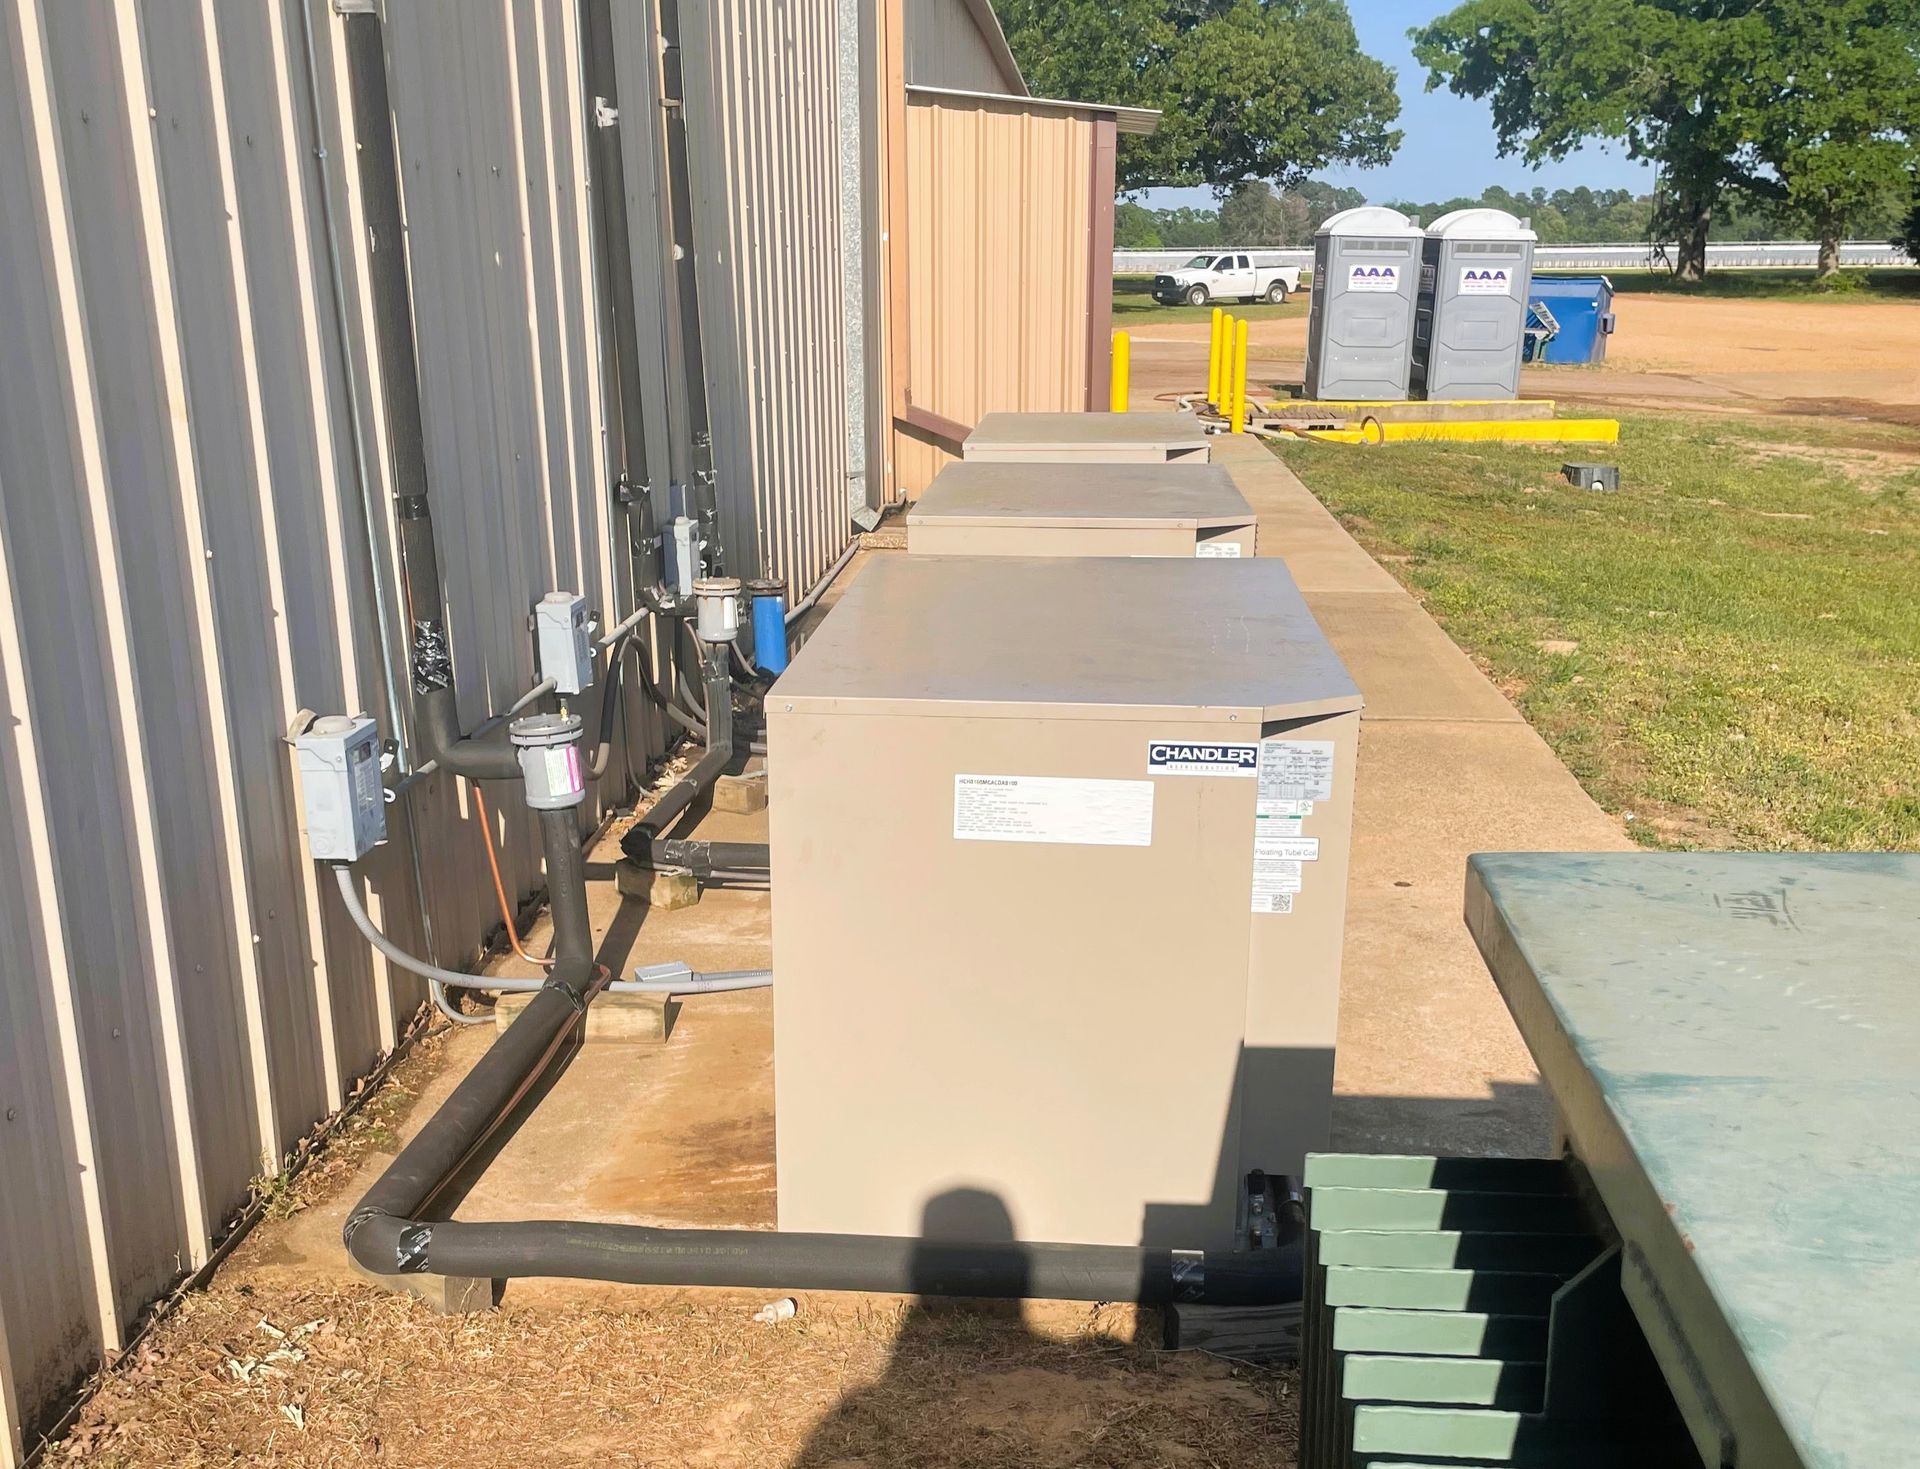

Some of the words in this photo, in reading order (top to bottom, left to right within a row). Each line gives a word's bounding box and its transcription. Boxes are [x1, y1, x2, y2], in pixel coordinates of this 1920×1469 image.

[1352, 267, 1395, 277] AAA
[1464, 270, 1507, 280] AAA
[1151, 746, 1255, 764] CHANDLER
[1255, 848, 1283, 857] Floating
[1284, 848, 1301, 856] Tube
